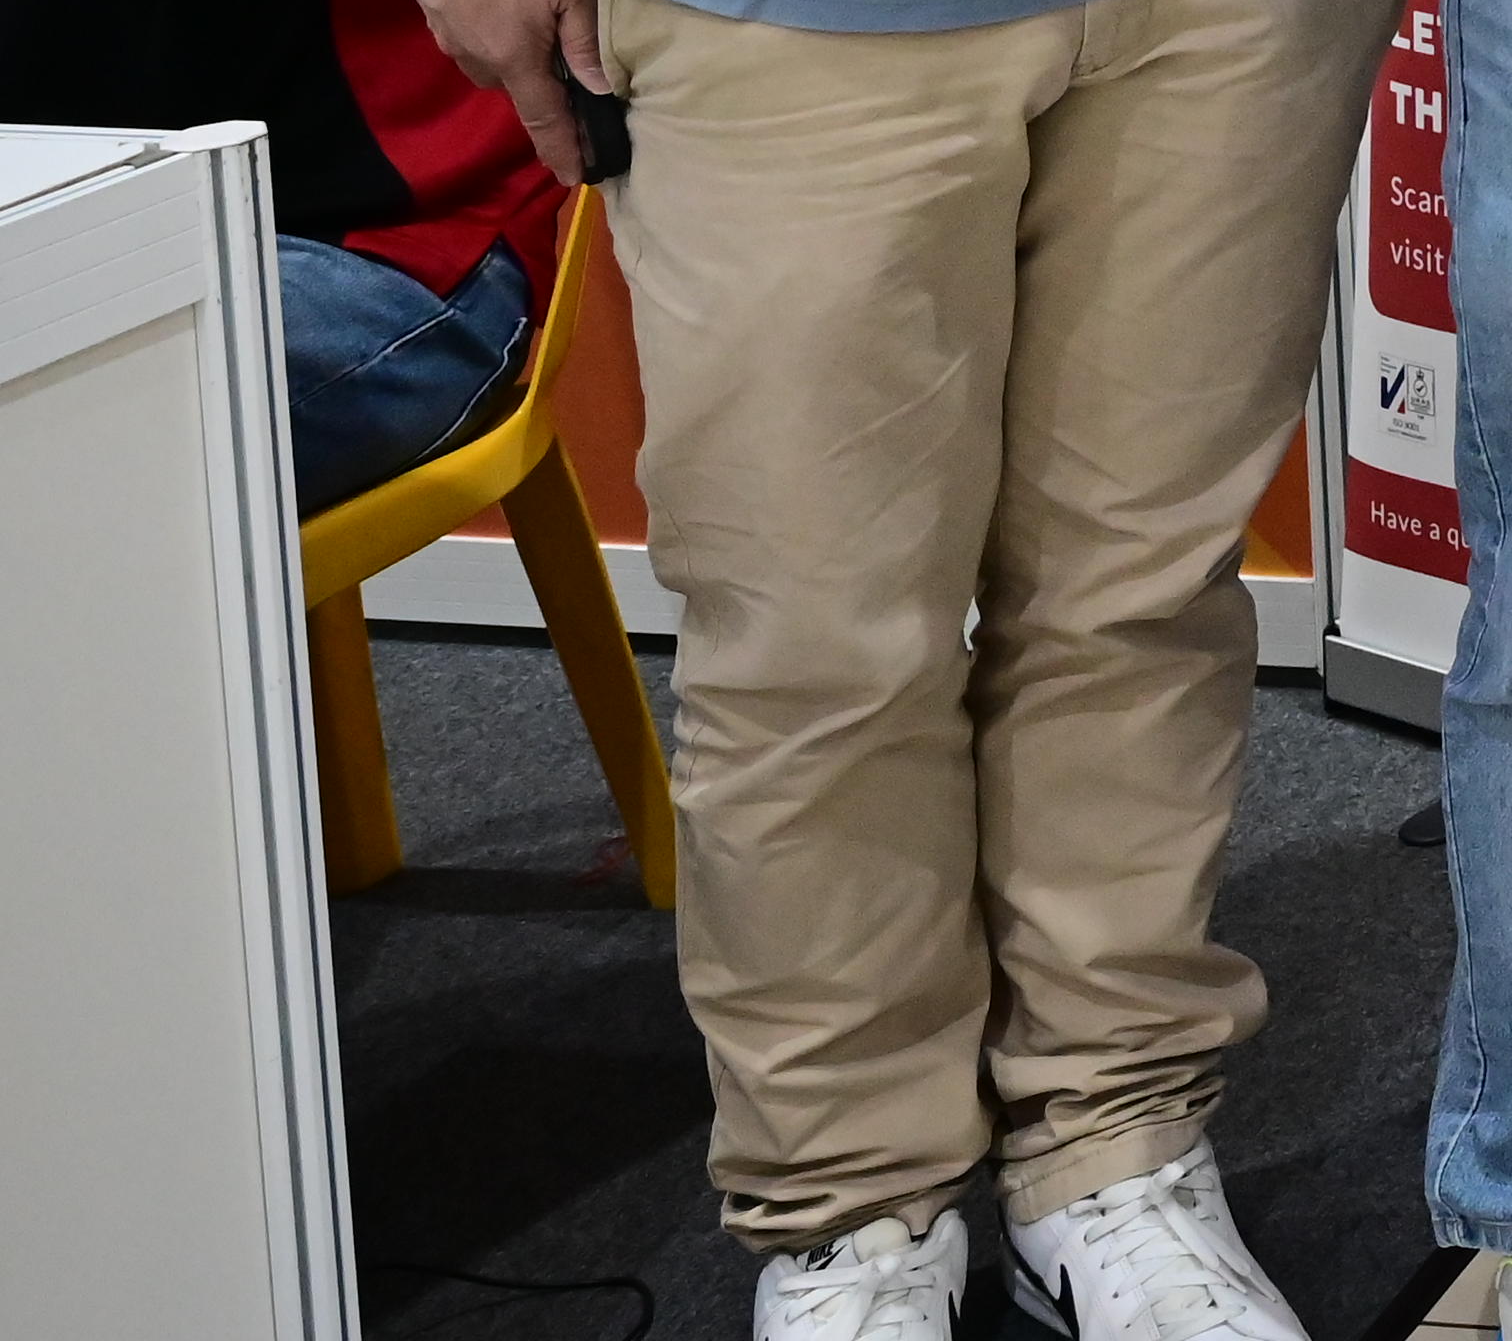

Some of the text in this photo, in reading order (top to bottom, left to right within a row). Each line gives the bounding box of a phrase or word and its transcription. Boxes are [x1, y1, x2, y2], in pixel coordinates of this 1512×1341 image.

[1390, 239, 1446, 276] visit
[1369, 498, 1424, 536] Have
[1428, 521, 1442, 541] a
